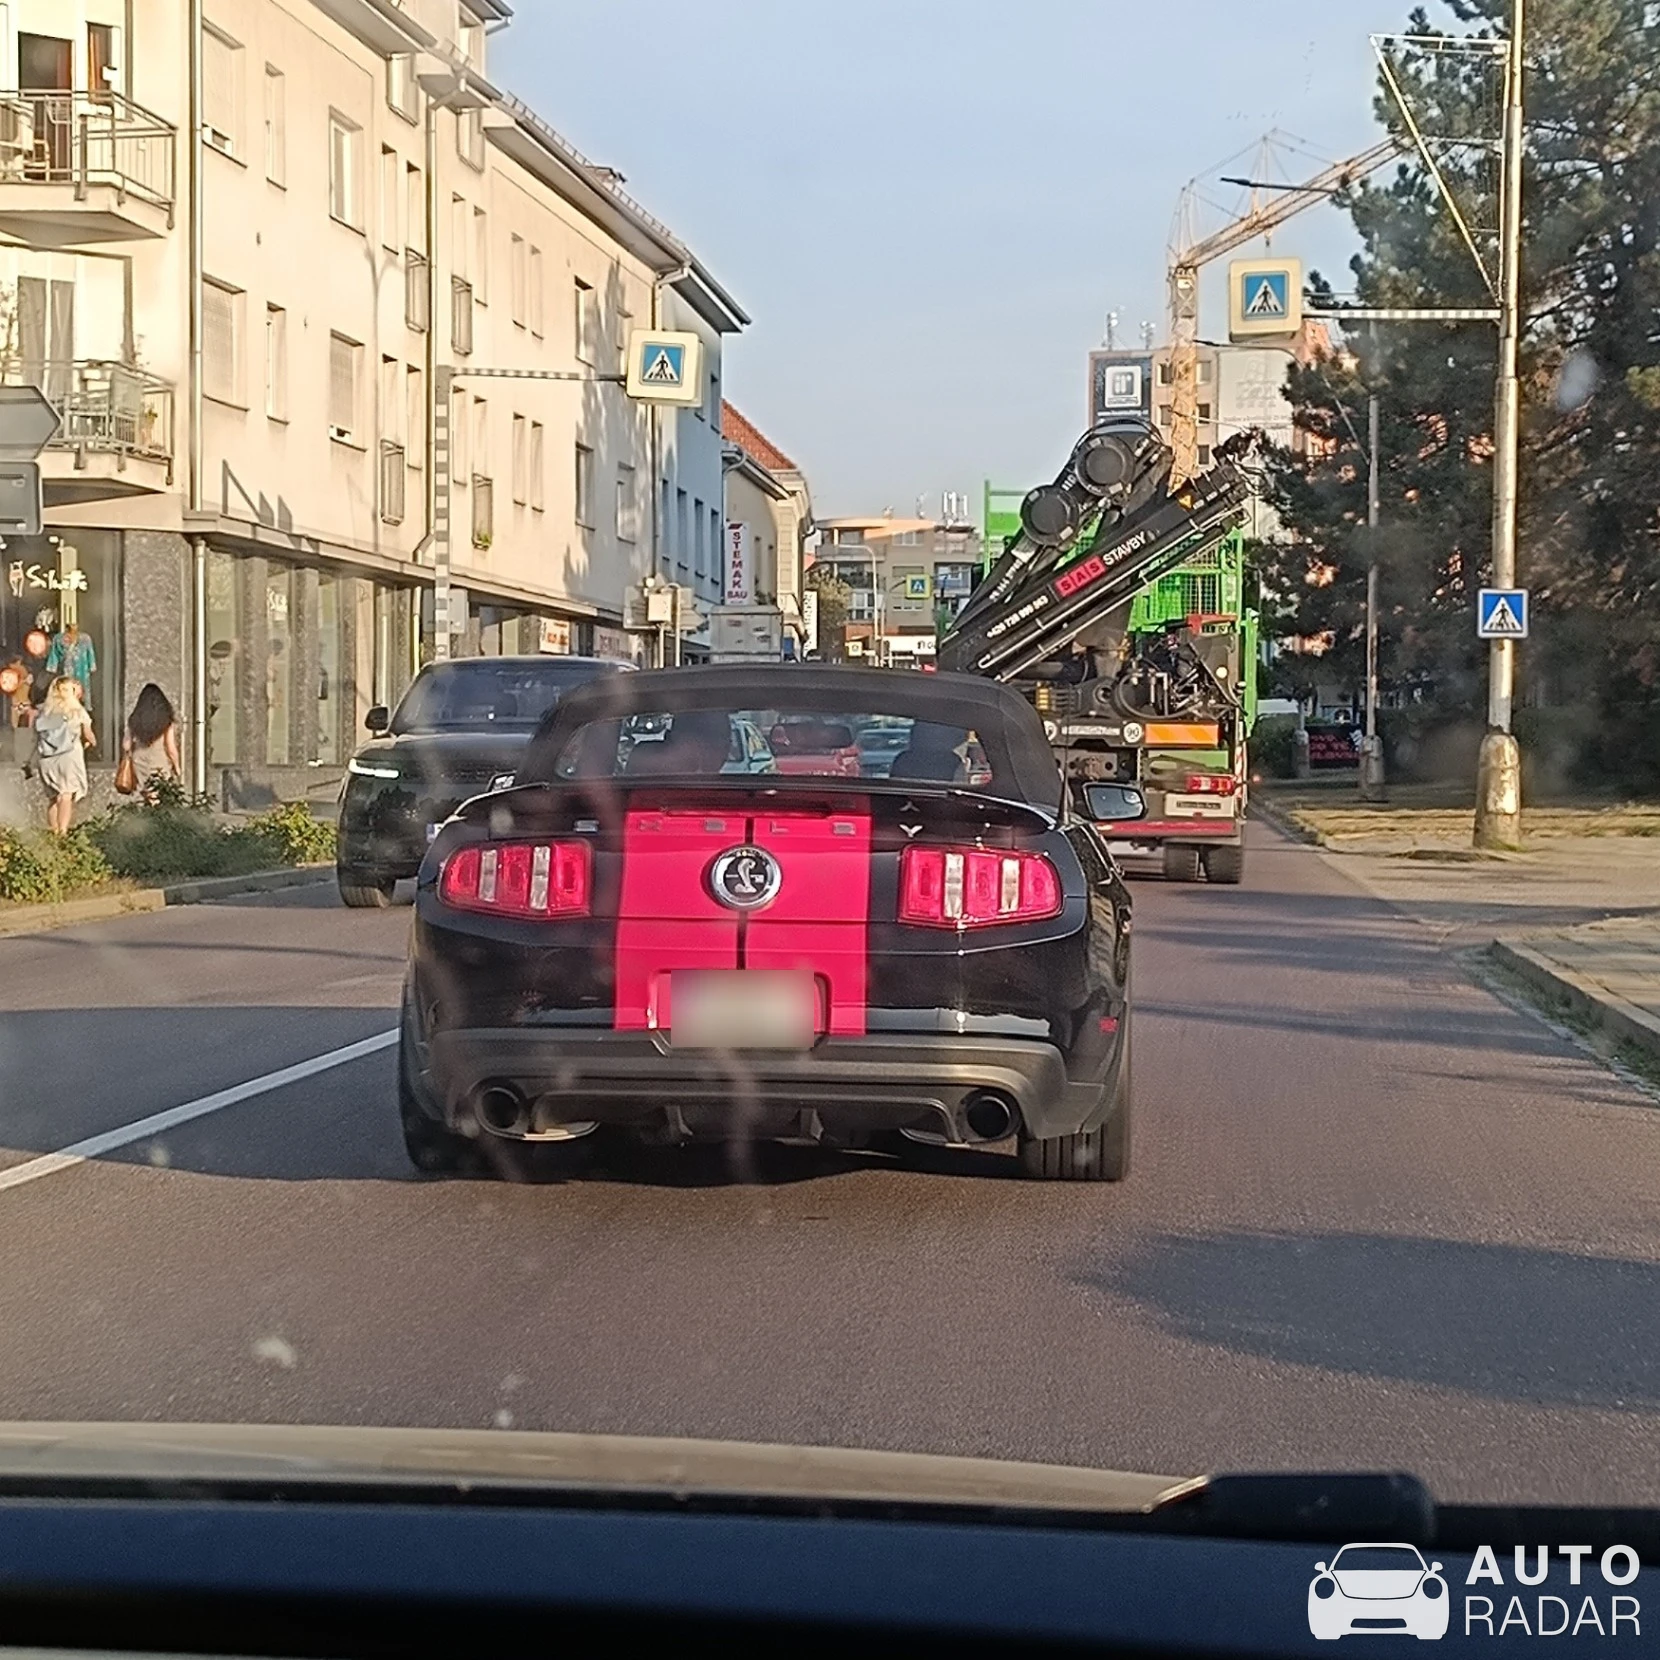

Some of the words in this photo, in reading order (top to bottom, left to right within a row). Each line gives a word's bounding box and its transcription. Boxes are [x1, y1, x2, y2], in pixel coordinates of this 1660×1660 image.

[731, 531, 743, 589] STEMAK
[1102, 530, 1148, 566] STAVBY
[727, 590, 748, 599] BAU
